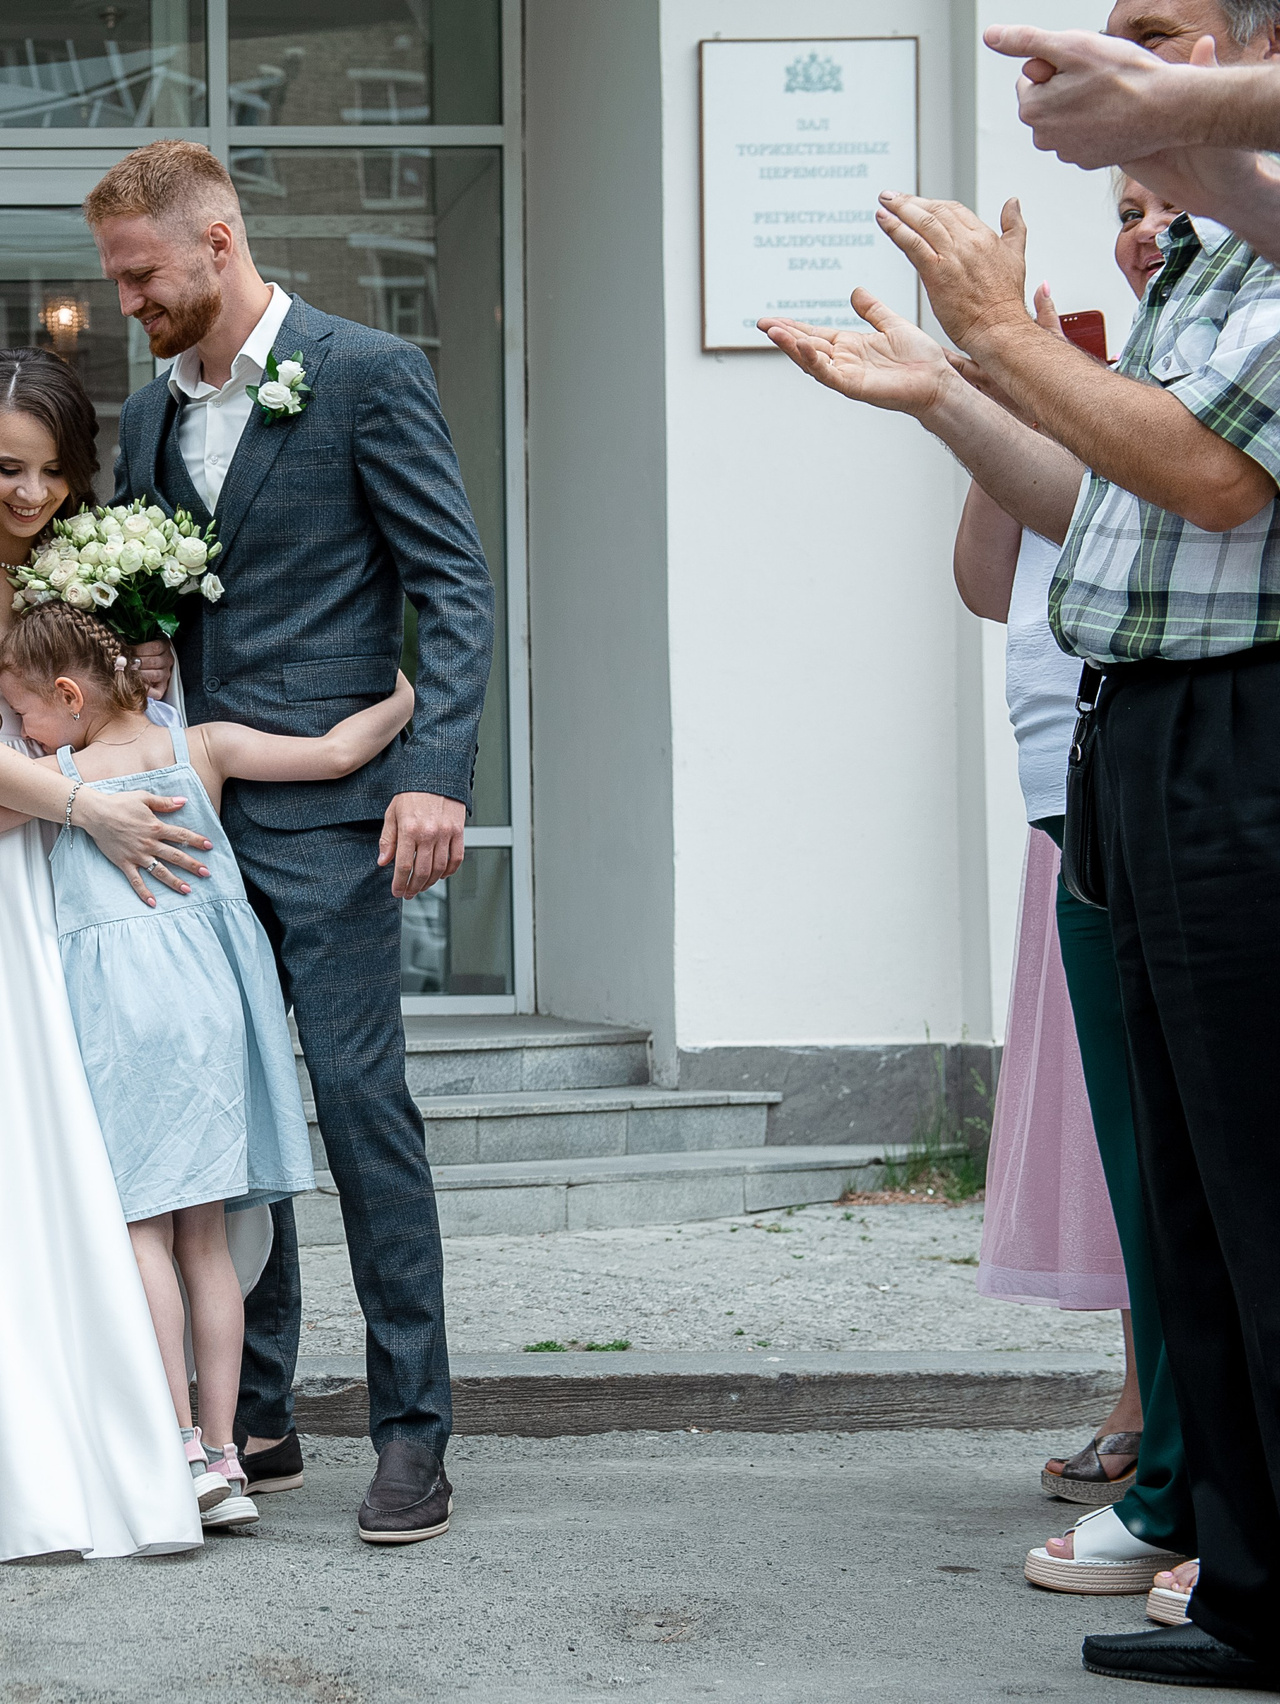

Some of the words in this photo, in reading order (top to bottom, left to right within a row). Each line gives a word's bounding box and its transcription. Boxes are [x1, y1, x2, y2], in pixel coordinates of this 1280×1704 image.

[796, 117, 830, 131] ЗАЛ
[735, 141, 889, 157] ТОРЖЕСТВЕННЫХ
[759, 162, 869, 181] ЦЕРЕМОНИЙ
[753, 209, 874, 225] РЕГИСТРАЦИЯ
[753, 232, 876, 249] ЗАКЛЮЧЕНИЯ
[787, 257, 843, 271] БРАКА
